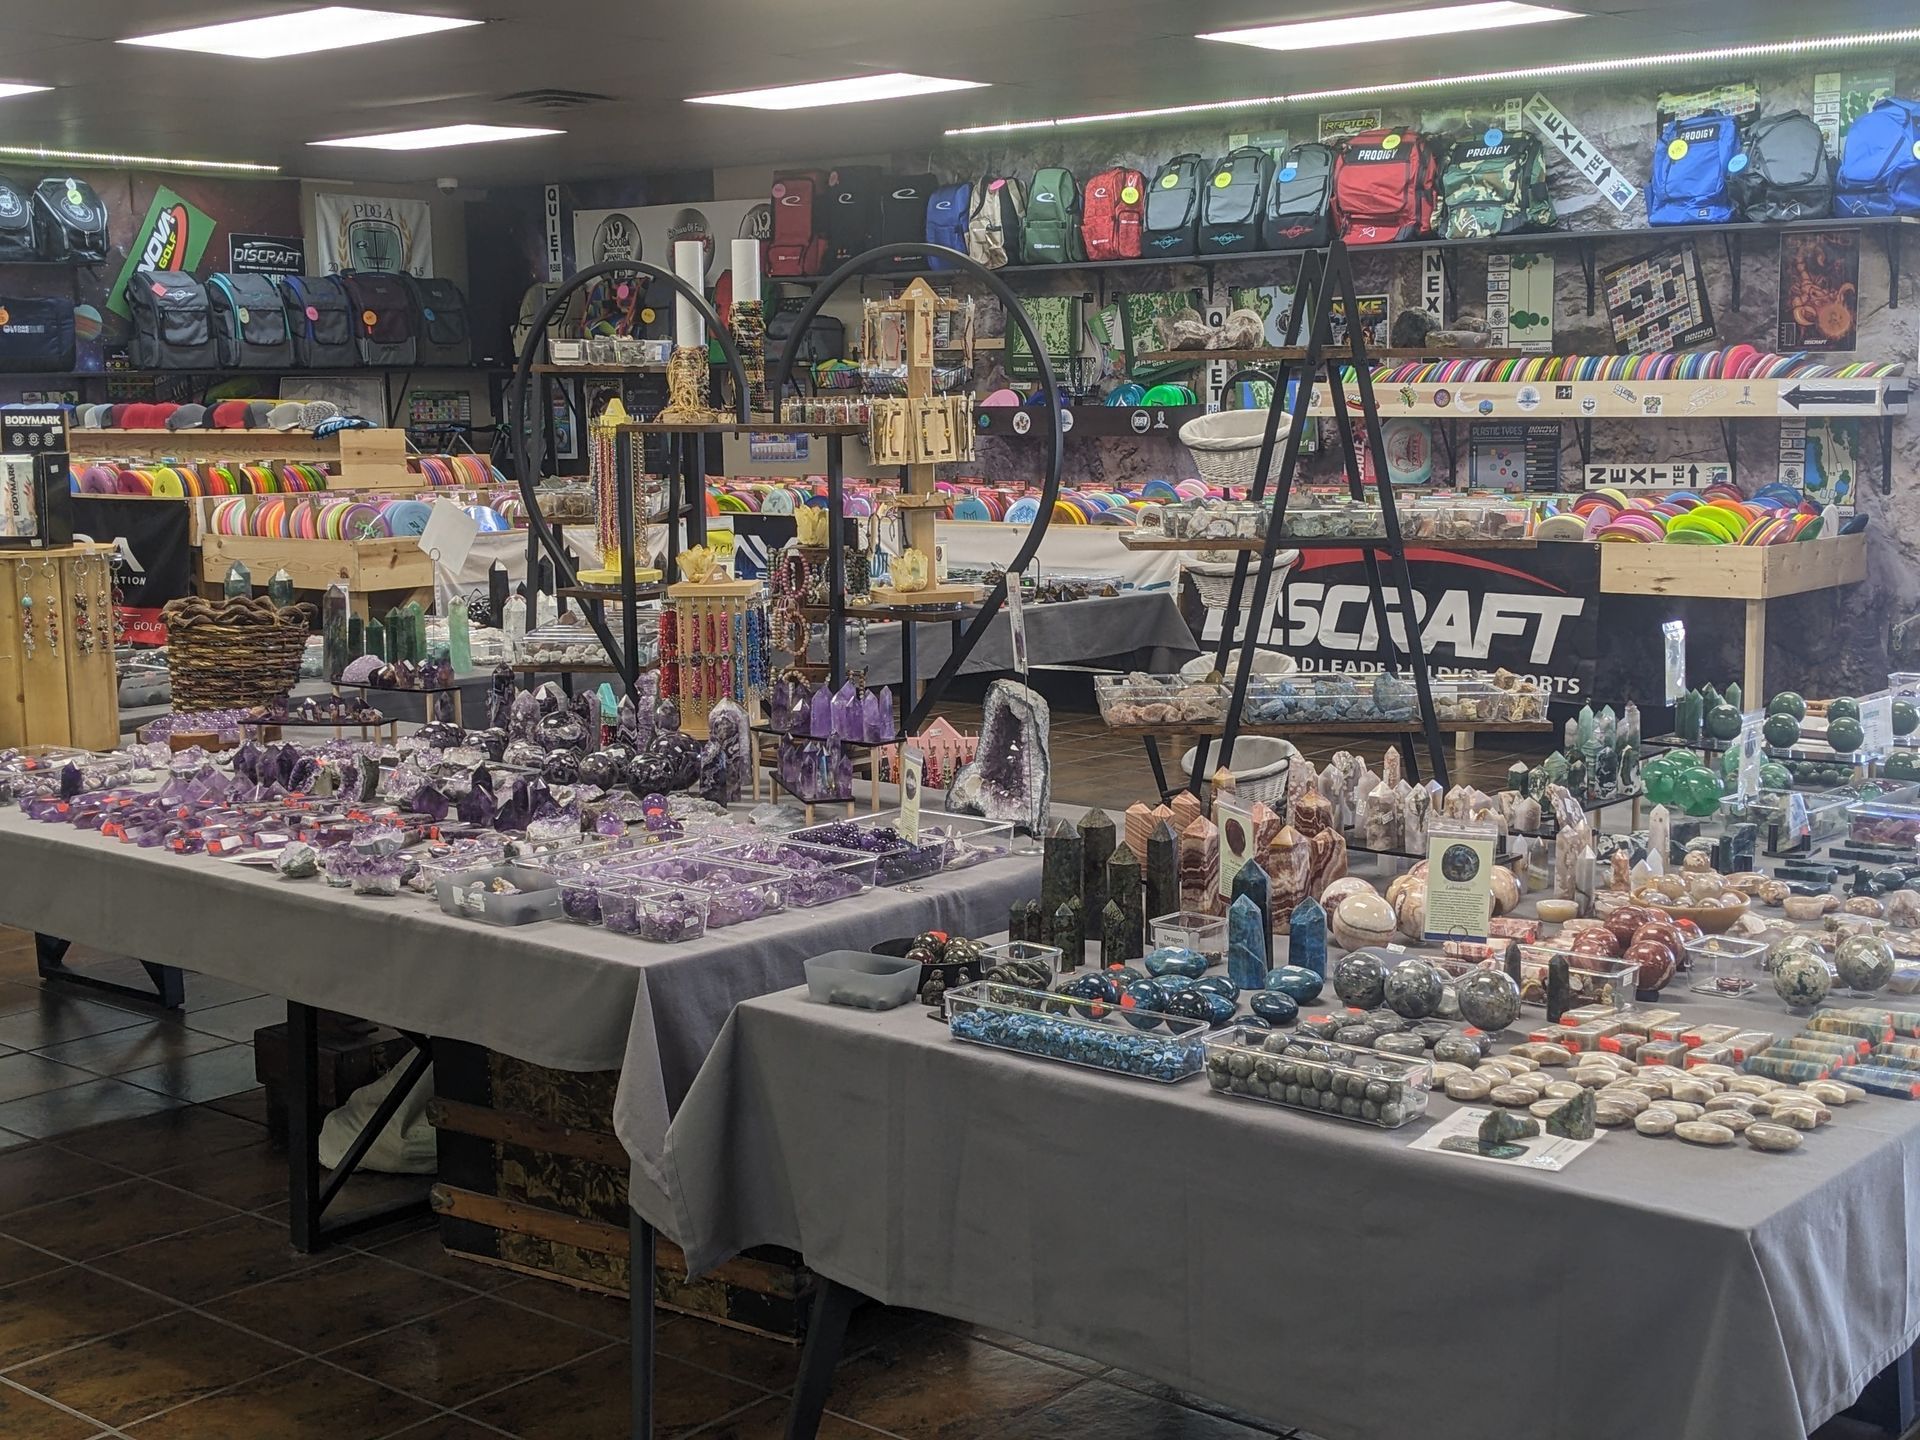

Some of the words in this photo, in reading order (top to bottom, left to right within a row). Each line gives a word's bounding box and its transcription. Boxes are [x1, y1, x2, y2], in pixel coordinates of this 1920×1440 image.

[1325, 118, 1375, 130] RAPTOR
[1528, 97, 1589, 160] NEXT
[1680, 127, 1714, 141] PRODIGY
[1357, 148, 1398, 161] PRODIGY
[1466, 144, 1511, 158] PRODIGY
[1583, 153, 1605, 176] TEE
[353, 204, 395, 221] PDGA
[547, 188, 559, 261] QUIET
[137, 209, 176, 272] NOVA
[158, 231, 177, 270] GOLF
[233, 248, 302, 265] DISCRAFT
[1425, 254, 1441, 314] NEX
[1332, 300, 1382, 315] NKE
[1208, 311, 1223, 401] QET
[4, 415, 61, 425] BODYMARK
[1472, 425, 1500, 436] PLASTIC
[1501, 425, 1523, 436] TYPES
[1527, 425, 1559, 434] INNOVA
[1589, 467, 1667, 485] NEXT
[1672, 464, 1685, 486] TEE
[7, 463, 20, 516] BODYMARK
[133, 621, 161, 631] GOLF
[1163, 935, 1184, 944] Dragon
